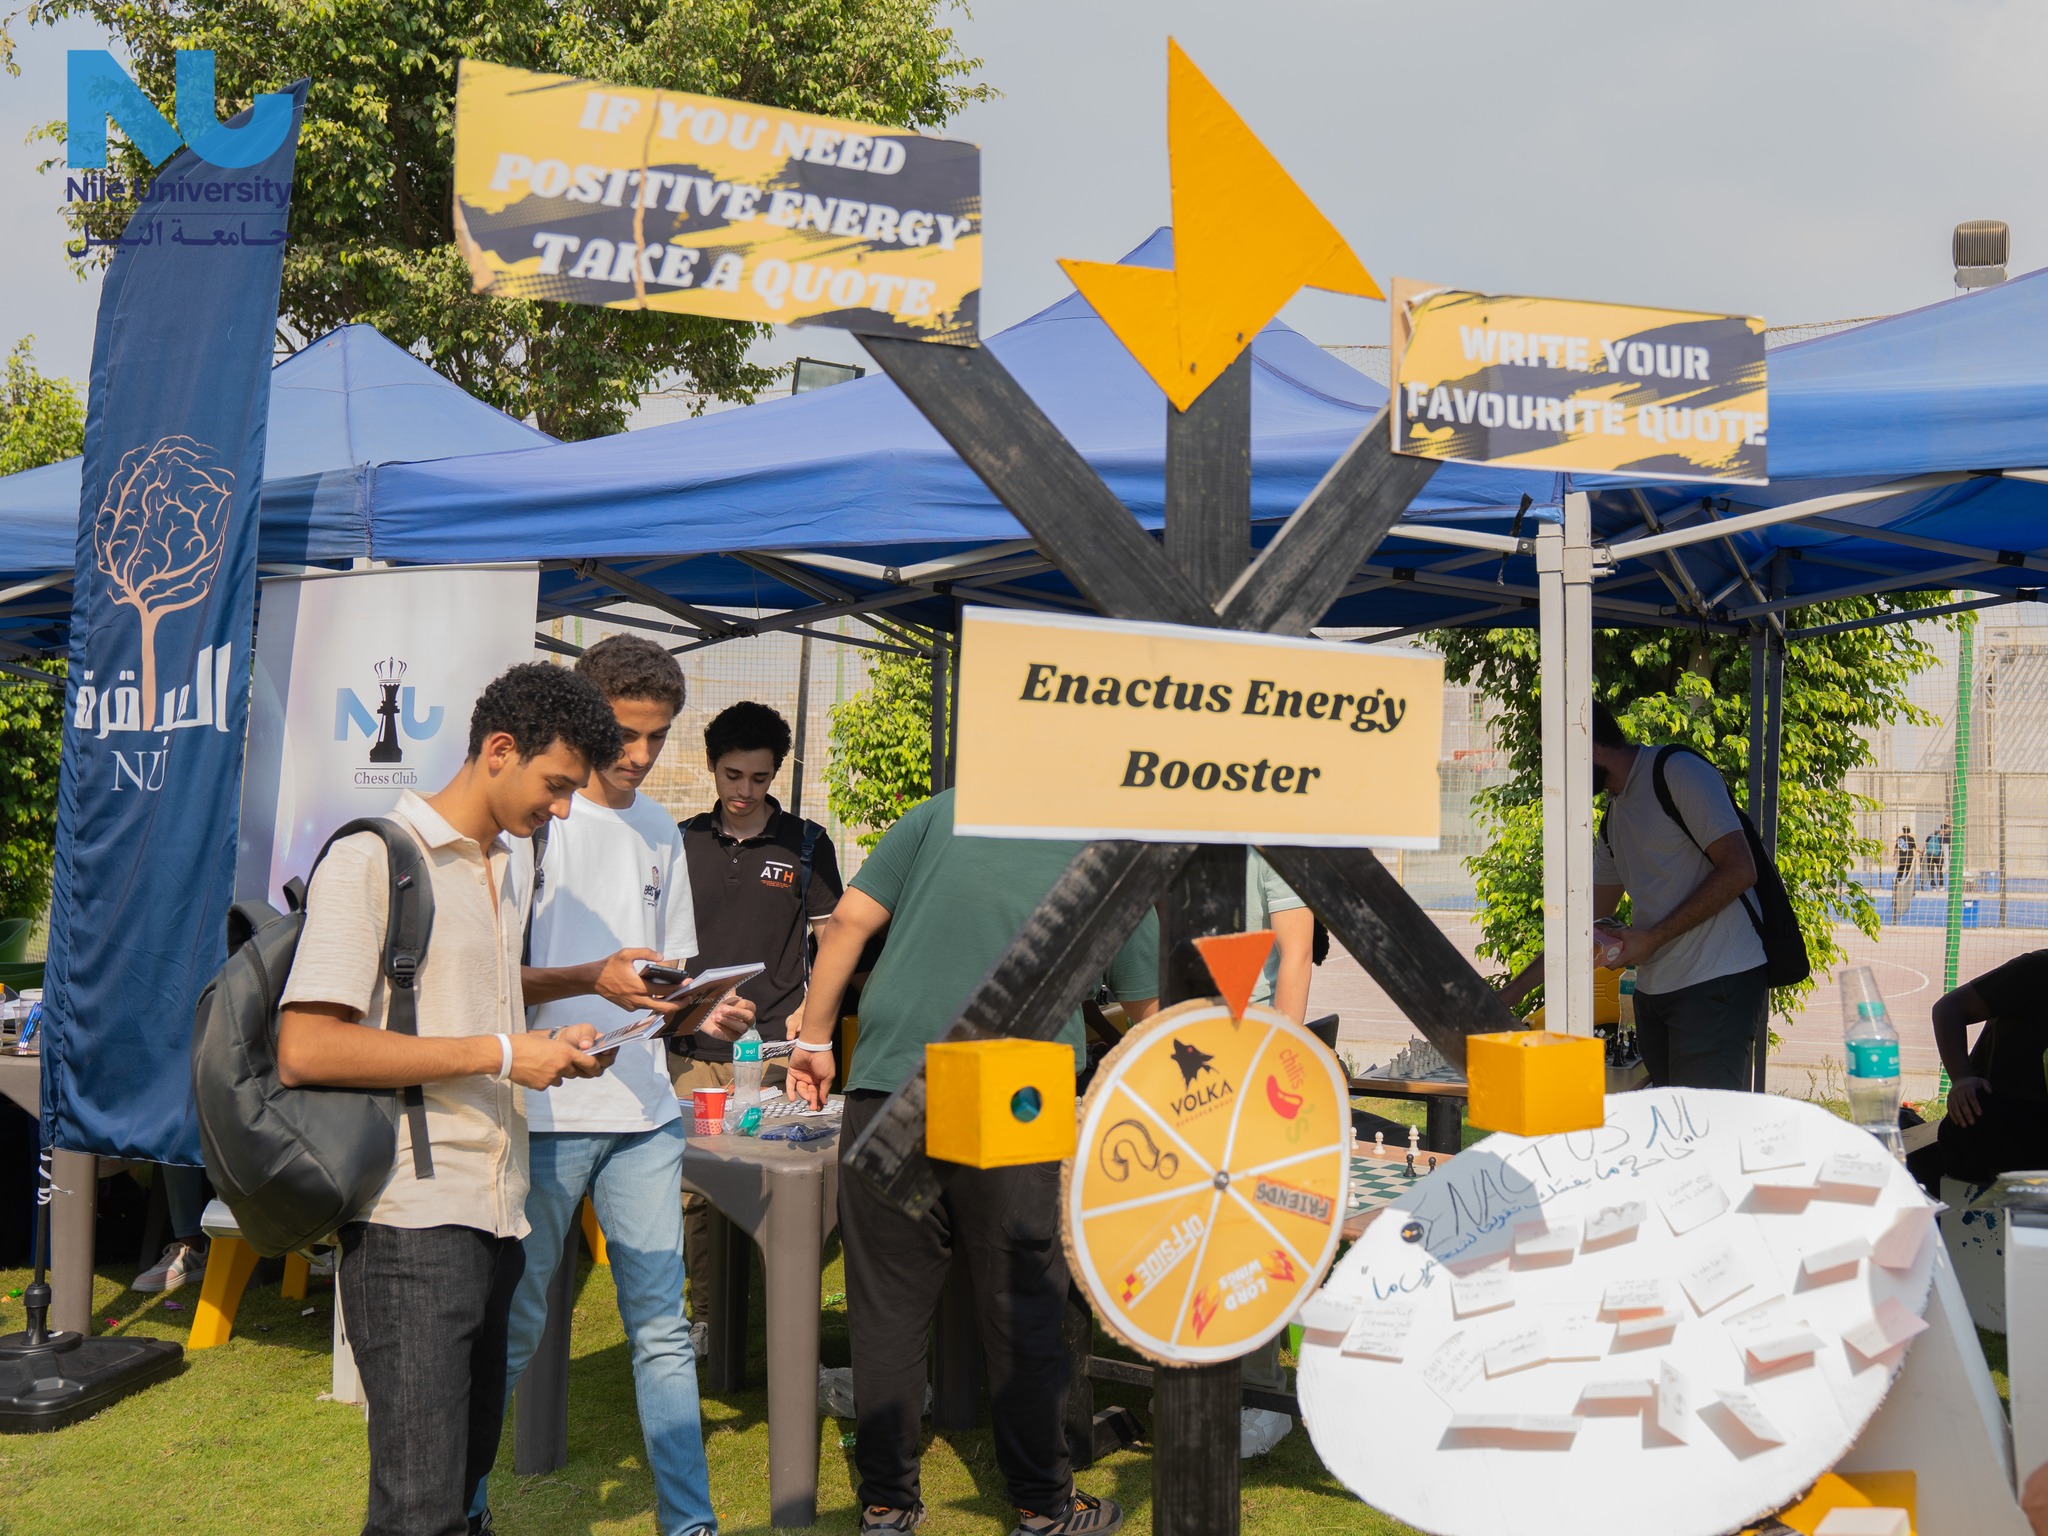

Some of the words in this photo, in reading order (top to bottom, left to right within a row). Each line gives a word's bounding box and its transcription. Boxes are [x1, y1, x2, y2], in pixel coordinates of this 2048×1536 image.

[579, 92, 641, 132] IF
[656, 100, 768, 151] YOU
[773, 125, 907, 176] NEED
[490, 152, 760, 222] POSITIVE
[767, 189, 972, 251] ENERGY
[532, 231, 699, 288] TAKE
[702, 252, 745, 293] A
[753, 258, 937, 317] QUOTE
[1459, 325, 1590, 372] WRITE
[1603, 340, 1711, 382] YOUR
[1407, 381, 1627, 436] FAVOURITE
[1637, 406, 1767, 446] QUOTE
[1019, 663, 1233, 713] Enactus
[1242, 680, 1407, 733] Energy
[111, 750, 169, 791] NU
[354, 772, 389, 785] Chess
[392, 772, 418, 785] Club
[1120, 751, 1321, 794] Booster
[760, 866, 794, 884] ATH
[1170, 1079, 1233, 1116] VOLKA
[1256, 1182, 1330, 1219] FRIENDS
[1135, 1213, 1204, 1287] OFFSIDE
[1224, 1277, 1267, 1311] LORD
